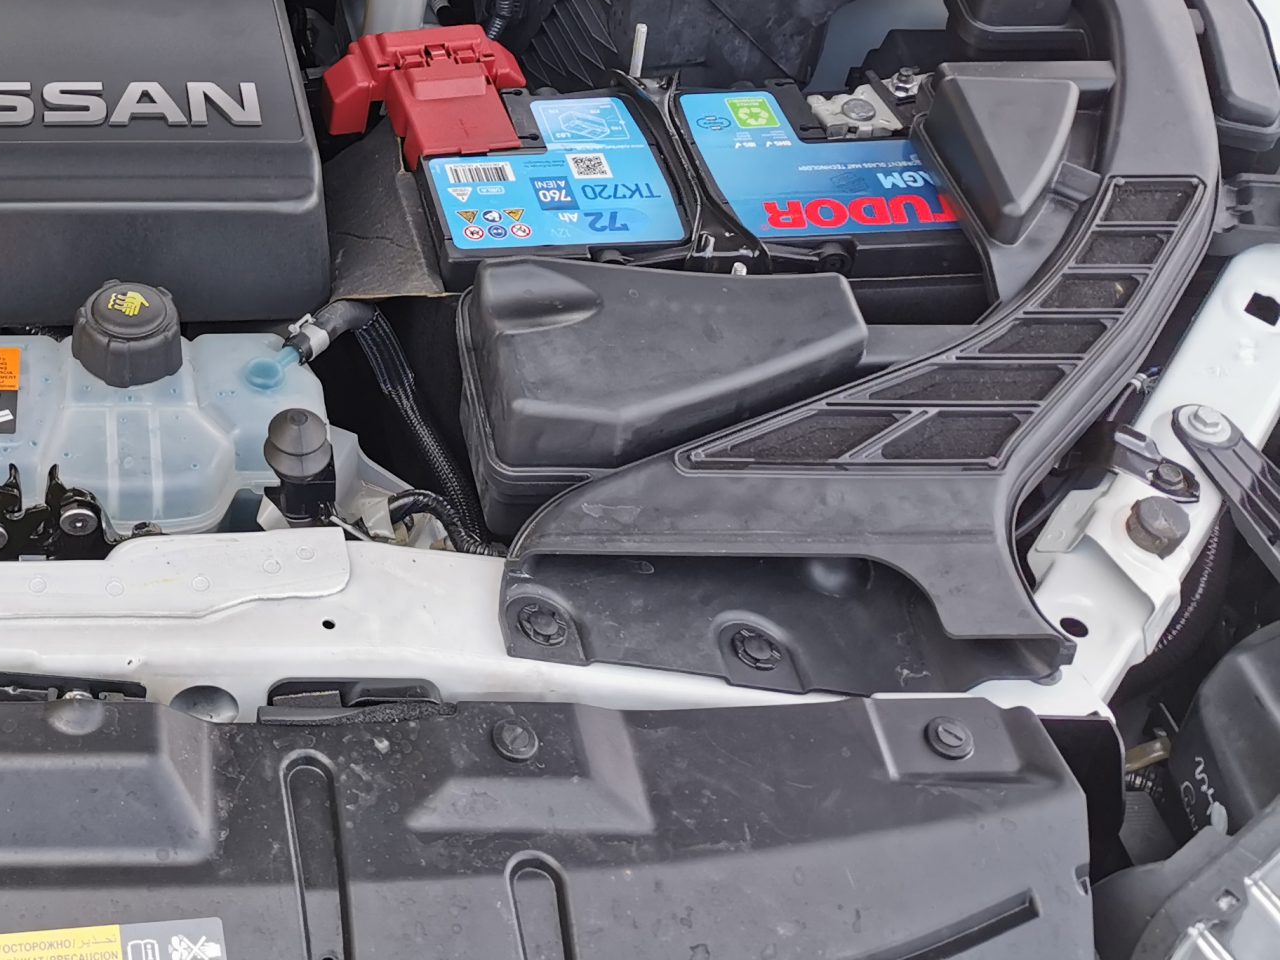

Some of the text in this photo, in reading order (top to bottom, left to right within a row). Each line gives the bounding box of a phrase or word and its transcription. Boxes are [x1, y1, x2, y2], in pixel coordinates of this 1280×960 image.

[538, 183, 662, 202] TK720 760
[557, 180, 566, 188] A
[558, 211, 630, 232] 72 Ah
[763, 194, 960, 230] TUDOR
